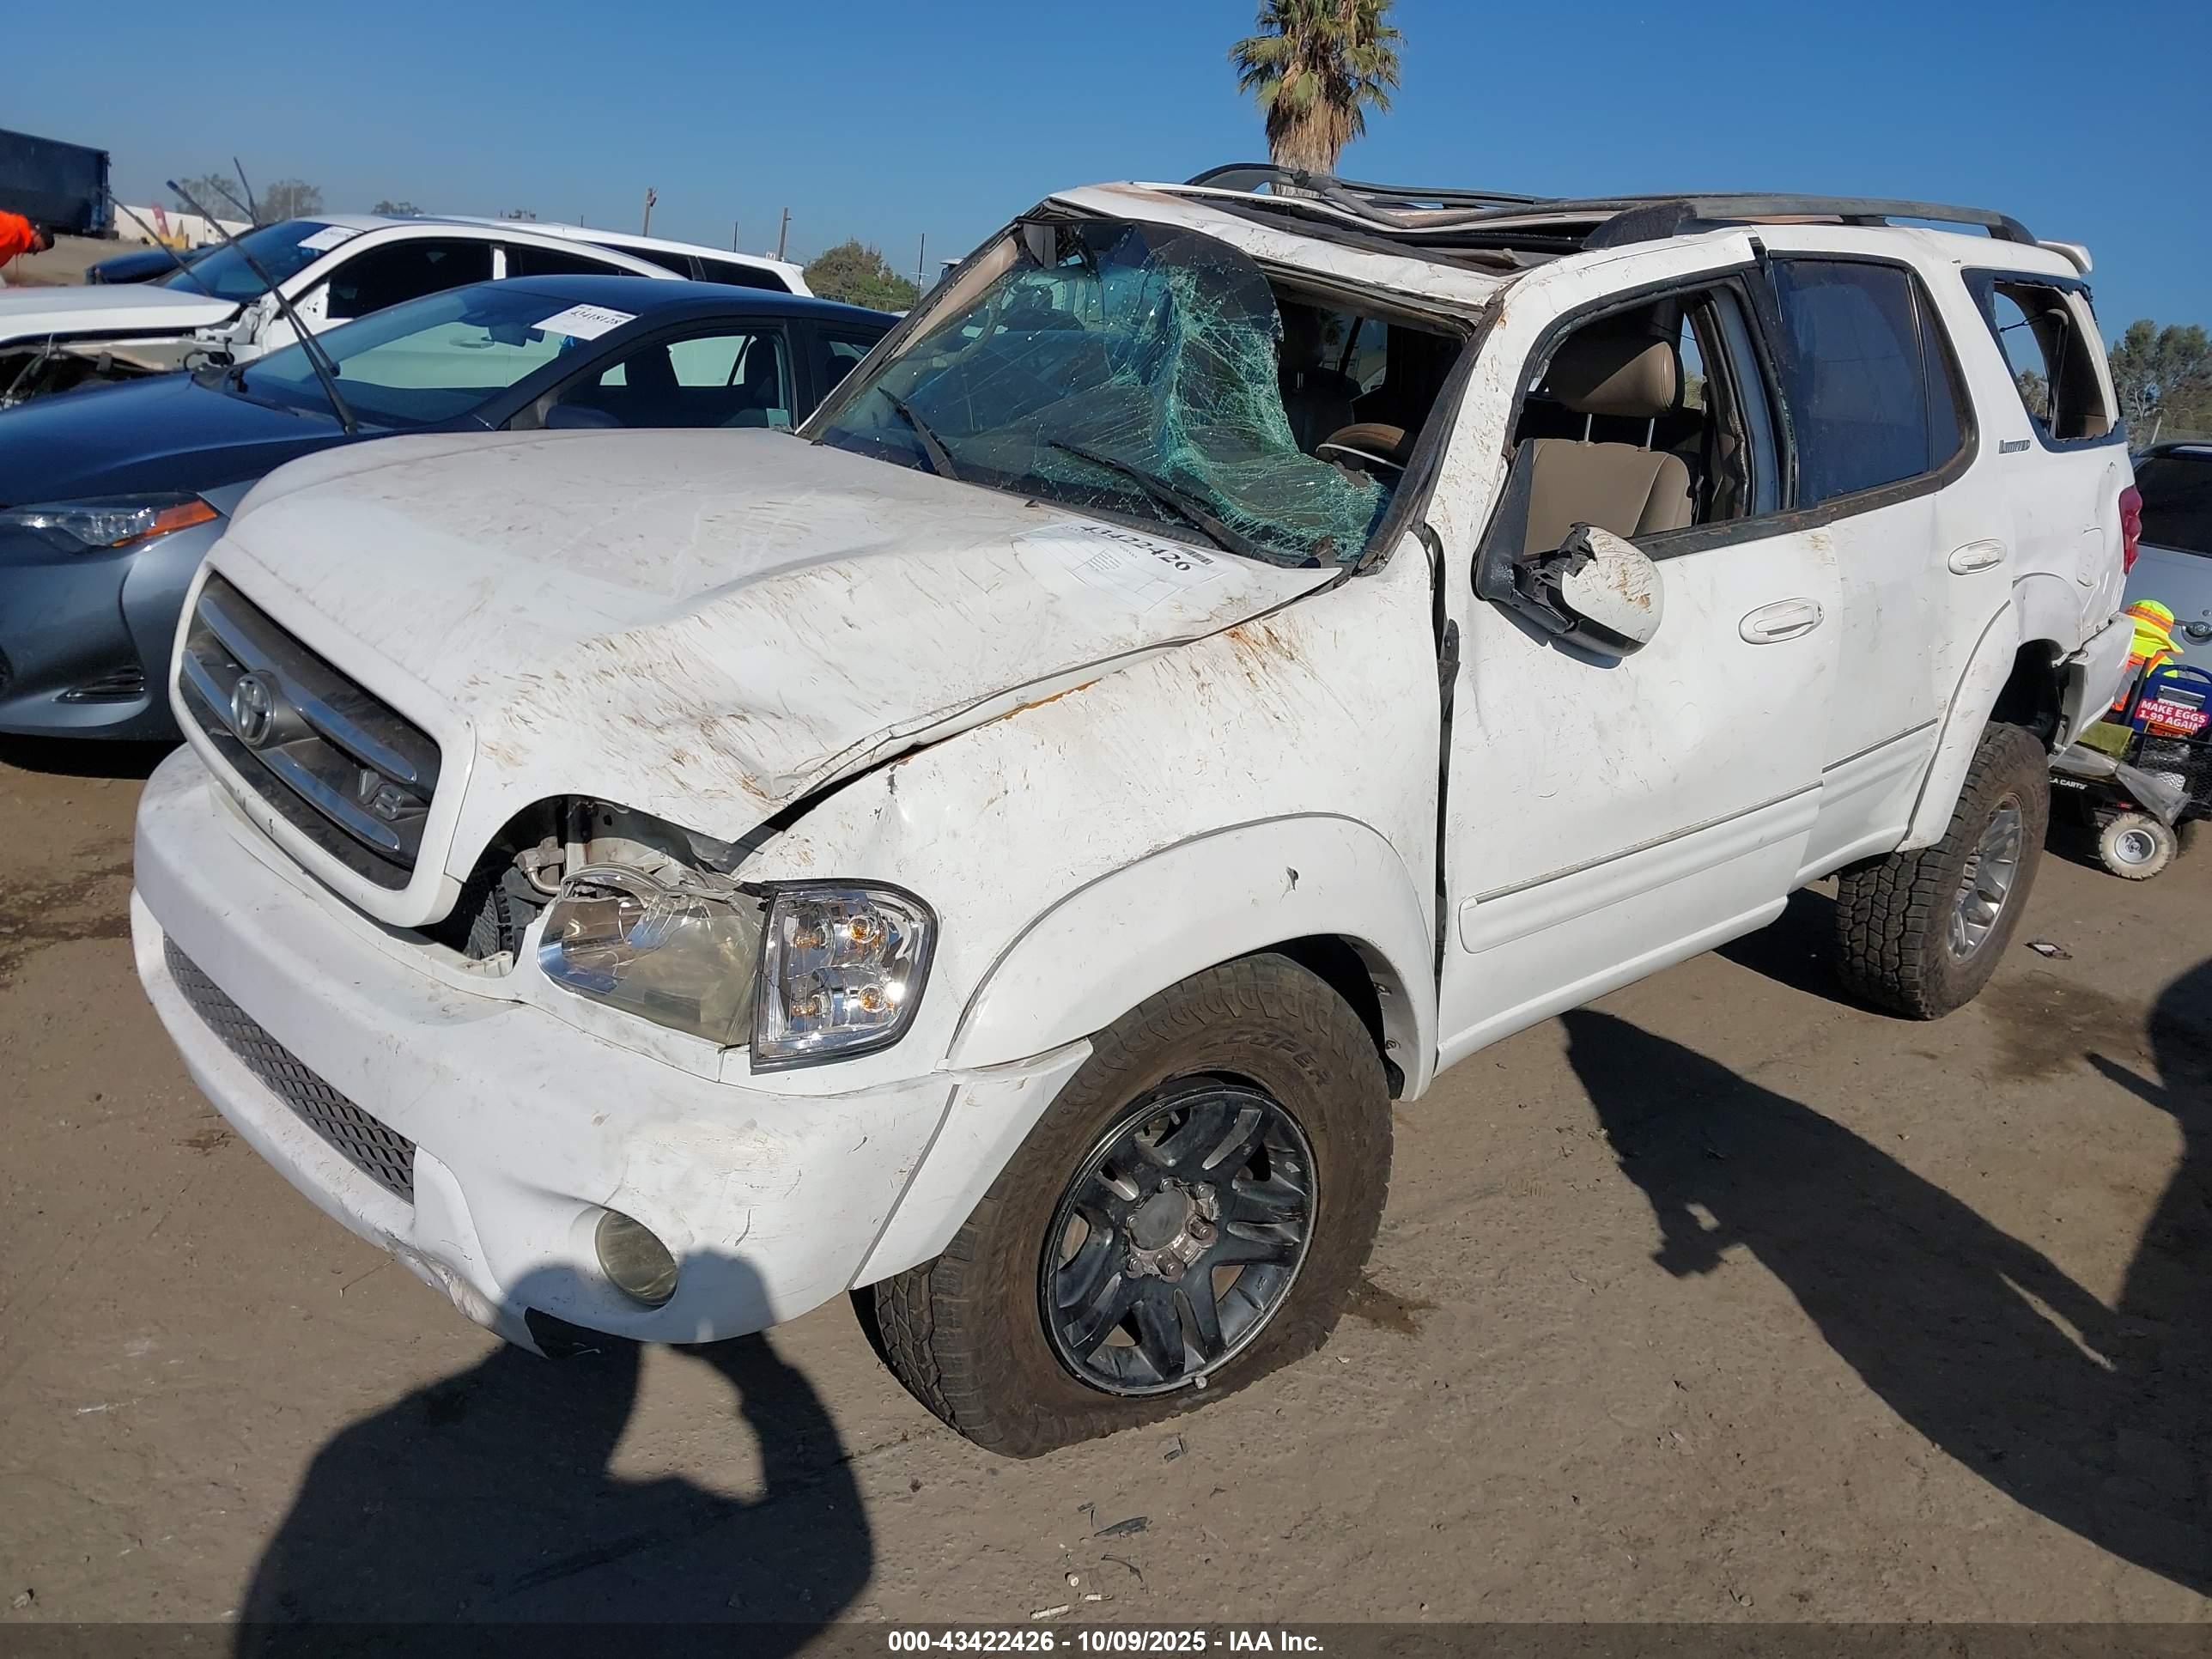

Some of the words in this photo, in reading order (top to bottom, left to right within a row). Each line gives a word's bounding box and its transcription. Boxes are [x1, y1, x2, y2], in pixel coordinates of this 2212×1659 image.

[1079, 525, 1193, 571] 43422426
[2139, 709, 2164, 722] 1.99
[2141, 700, 2173, 715] MAKE
[2174, 708, 2207, 723] EGGS
